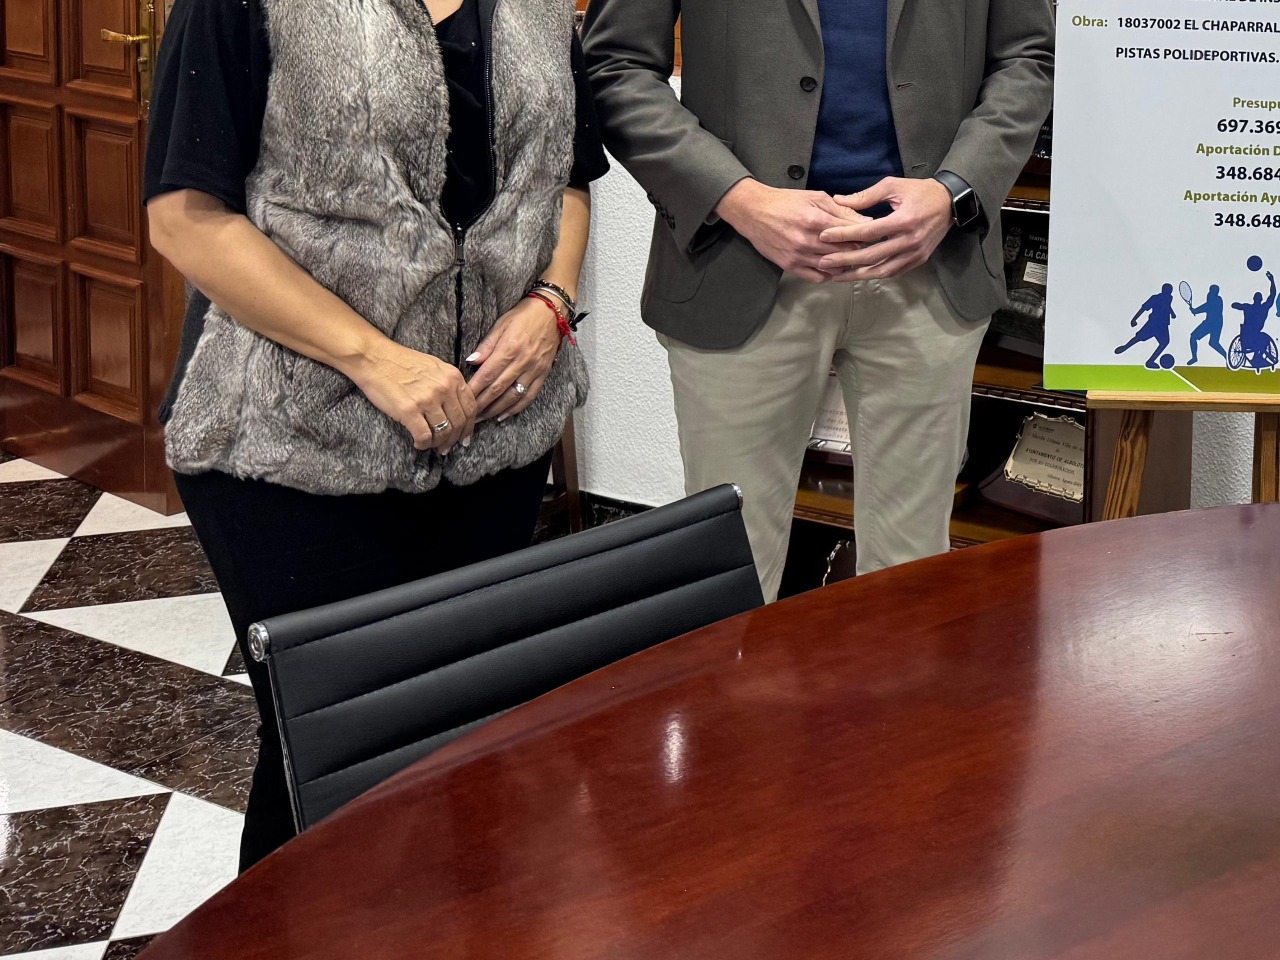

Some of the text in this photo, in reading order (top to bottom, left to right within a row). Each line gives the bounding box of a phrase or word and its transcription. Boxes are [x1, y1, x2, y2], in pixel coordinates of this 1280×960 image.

[1072, 15, 1108, 27] Obra:
[1117, 17, 1181, 29] 18037002
[1184, 19, 1199, 30] EL
[1116, 47, 1279, 63] PISTAS POLIDEPORTIVAS.
[1196, 143, 1270, 157] Aportación
[1183, 190, 1257, 204] Aportación
[1024, 248, 1034, 258] LA
